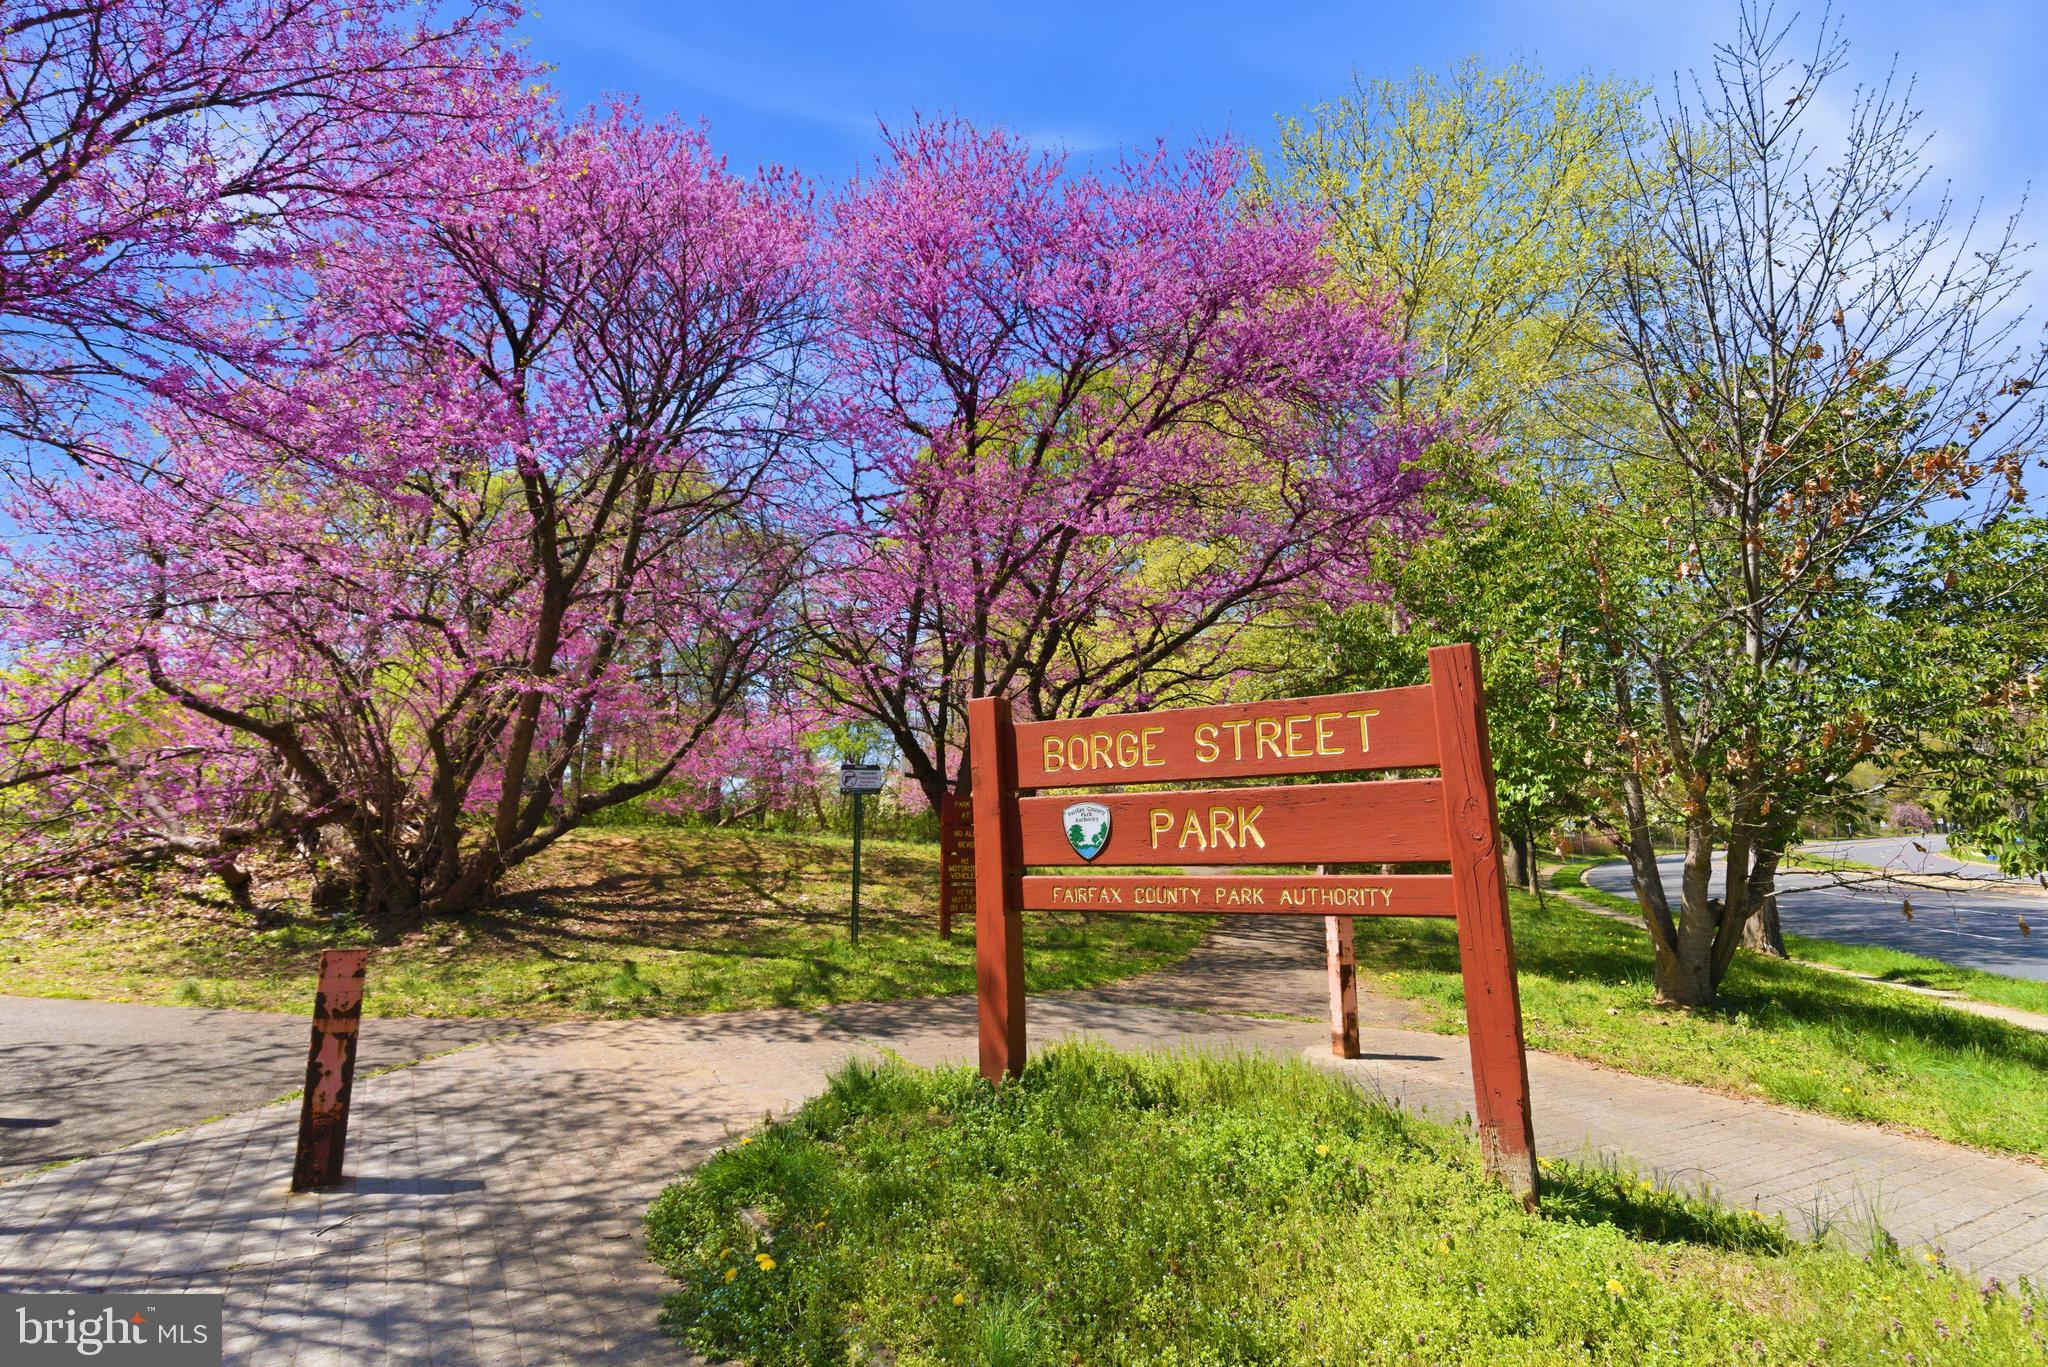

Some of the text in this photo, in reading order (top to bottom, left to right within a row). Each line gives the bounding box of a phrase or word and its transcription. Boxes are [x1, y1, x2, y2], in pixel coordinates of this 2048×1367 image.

[1043, 708, 1380, 773] BORGE STREET
[1068, 806, 1106, 816] Fairfax County
[1149, 804, 1266, 850] PARK
[1052, 886, 1393, 907] FAIRFAX COUNTY PARK AUTHORITY
